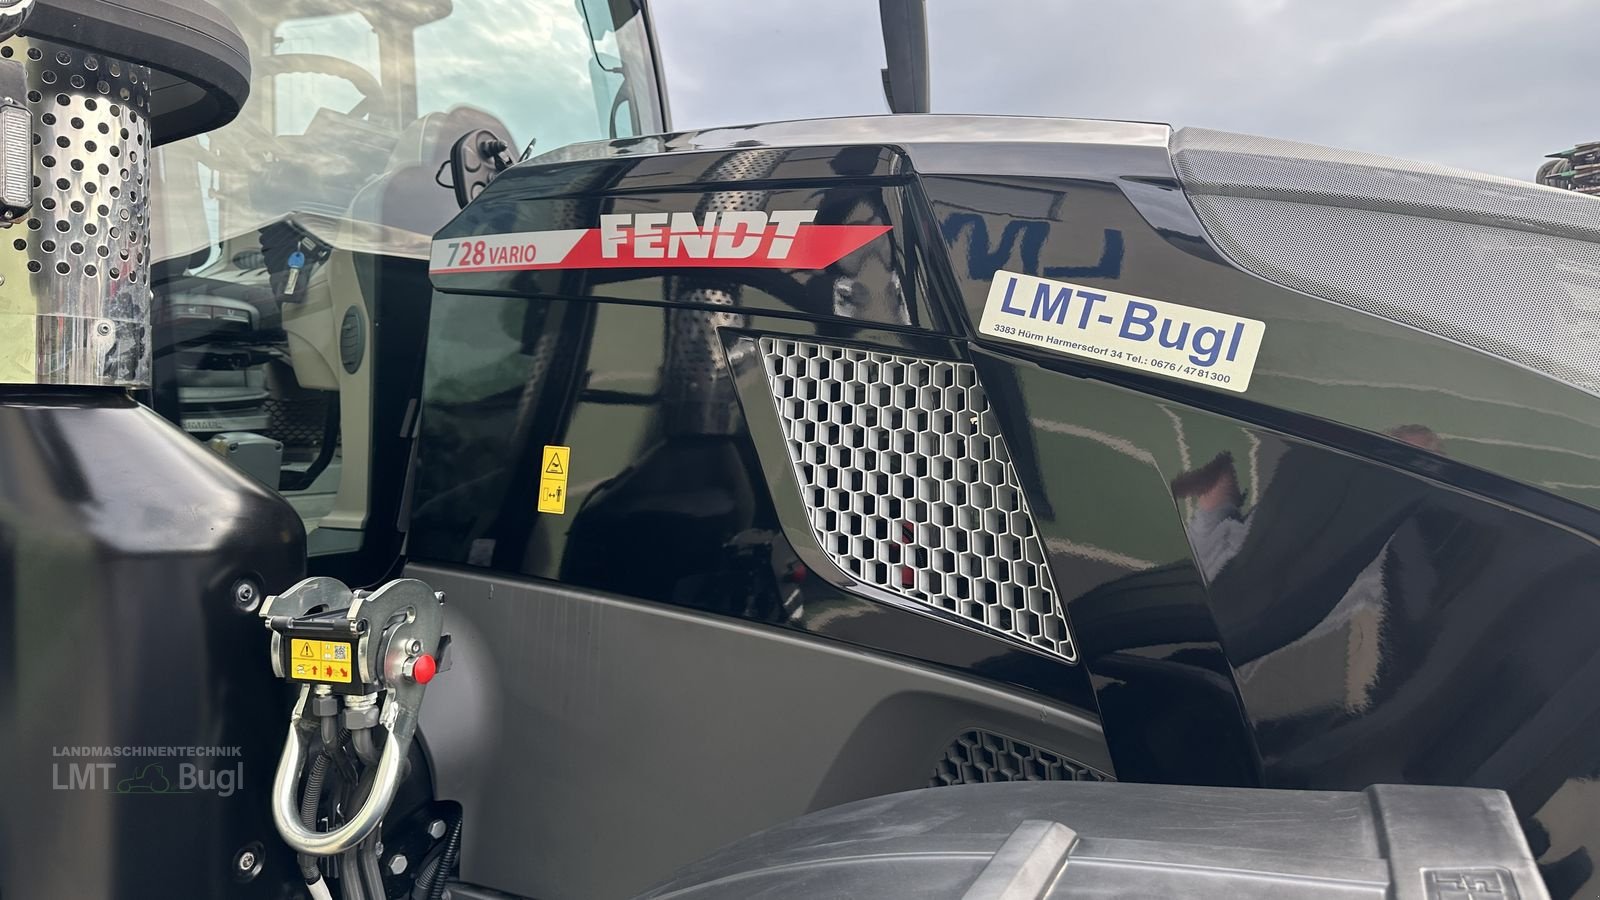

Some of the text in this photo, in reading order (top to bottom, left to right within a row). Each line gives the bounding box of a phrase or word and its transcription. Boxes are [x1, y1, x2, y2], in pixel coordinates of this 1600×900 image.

[447, 240, 537, 267] 728 VARIO
[600, 209, 818, 260] FENDT
[994, 323, 1016, 335] 3383
[1017, 328, 1044, 342] Hürm
[1045, 334, 1109, 356] Harmersdorf
[1110, 349, 1123, 359] 34
[1125, 352, 1148, 365] Tel.:
[1000, 277, 1245, 368] LMT-Bugl
